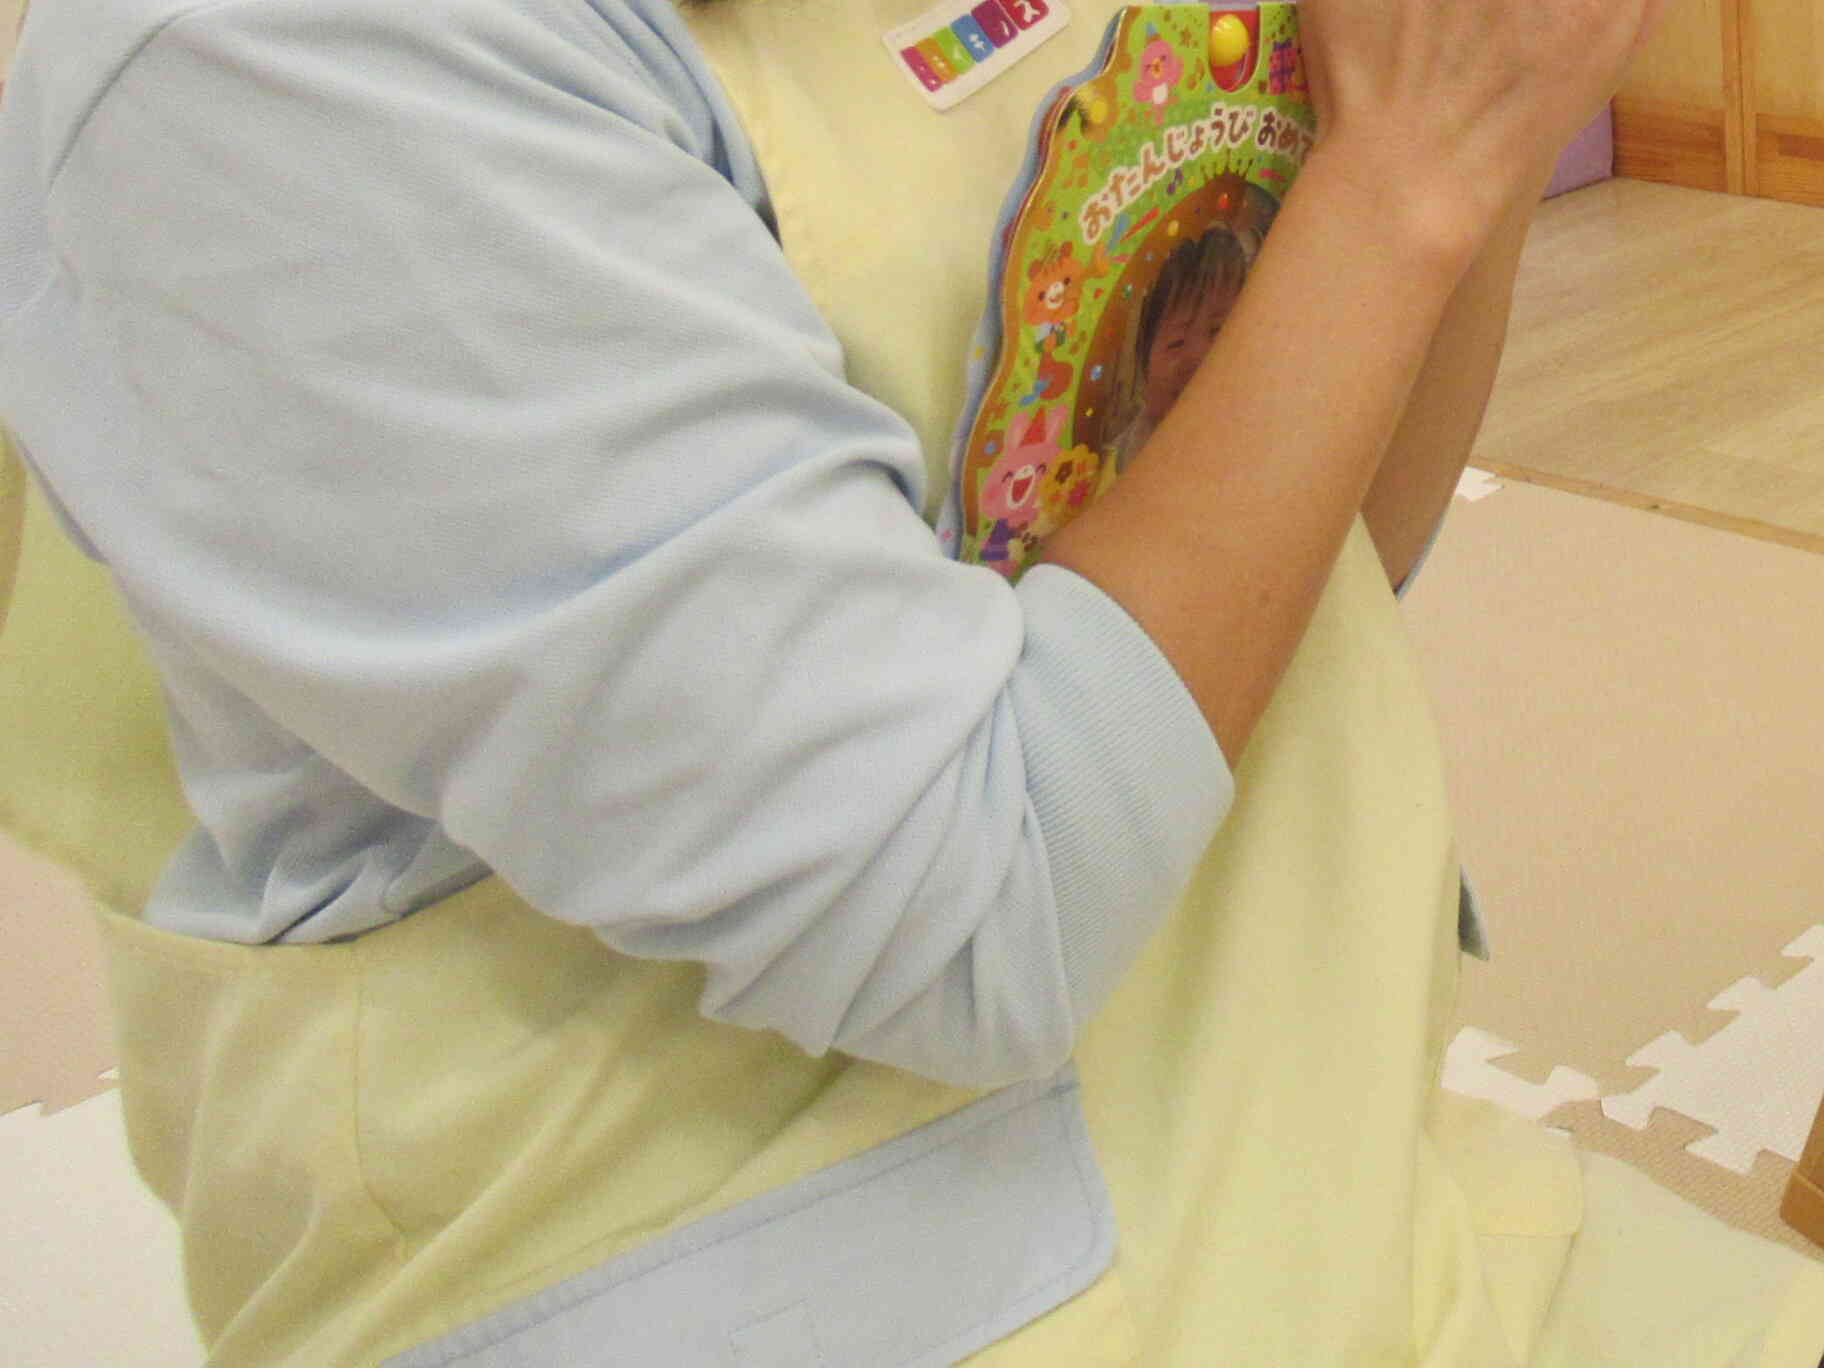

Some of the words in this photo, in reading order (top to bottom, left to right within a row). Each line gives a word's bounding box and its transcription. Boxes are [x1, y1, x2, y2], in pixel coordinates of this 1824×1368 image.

[1080, 107, 1254, 241] おたんじょうび
